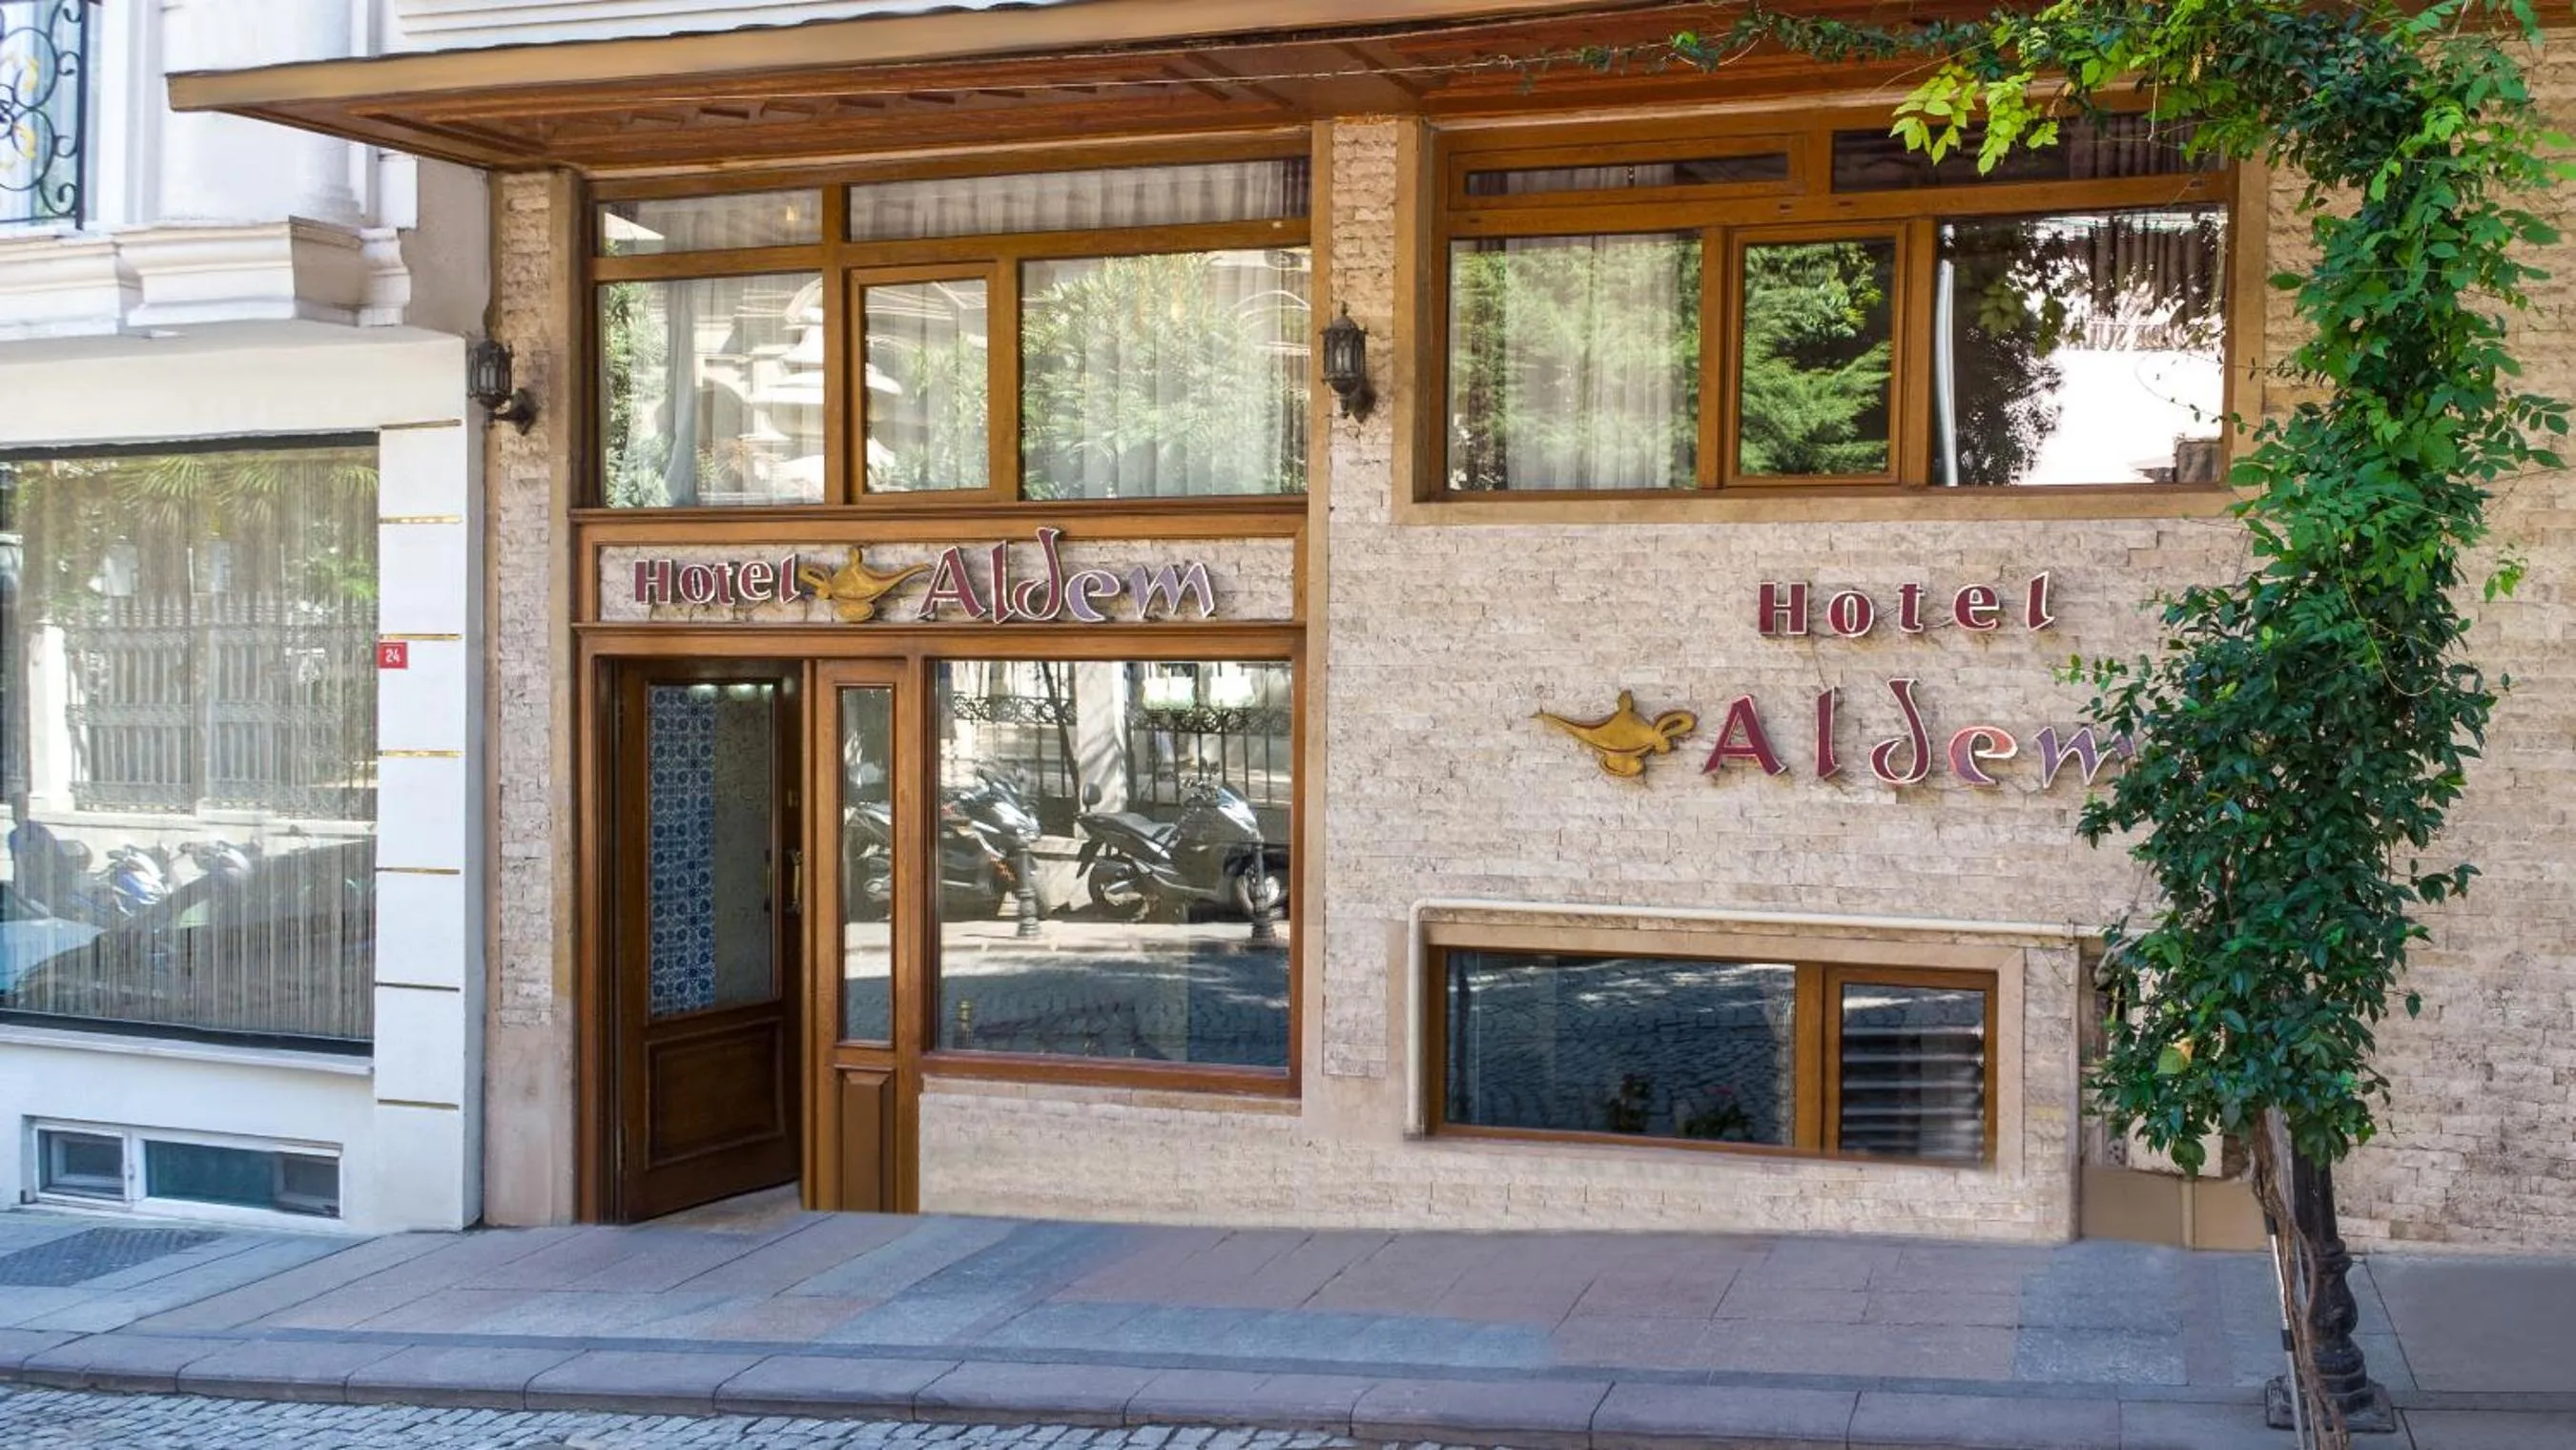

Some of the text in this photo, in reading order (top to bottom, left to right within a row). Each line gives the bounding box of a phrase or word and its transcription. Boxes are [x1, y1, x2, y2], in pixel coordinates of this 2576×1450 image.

[634, 527, 1216, 624] Hotel Aldem
[1758, 570, 2055, 638] Hotel
[385, 648, 401, 663] 24
[1701, 678, 2136, 789] Aldem
